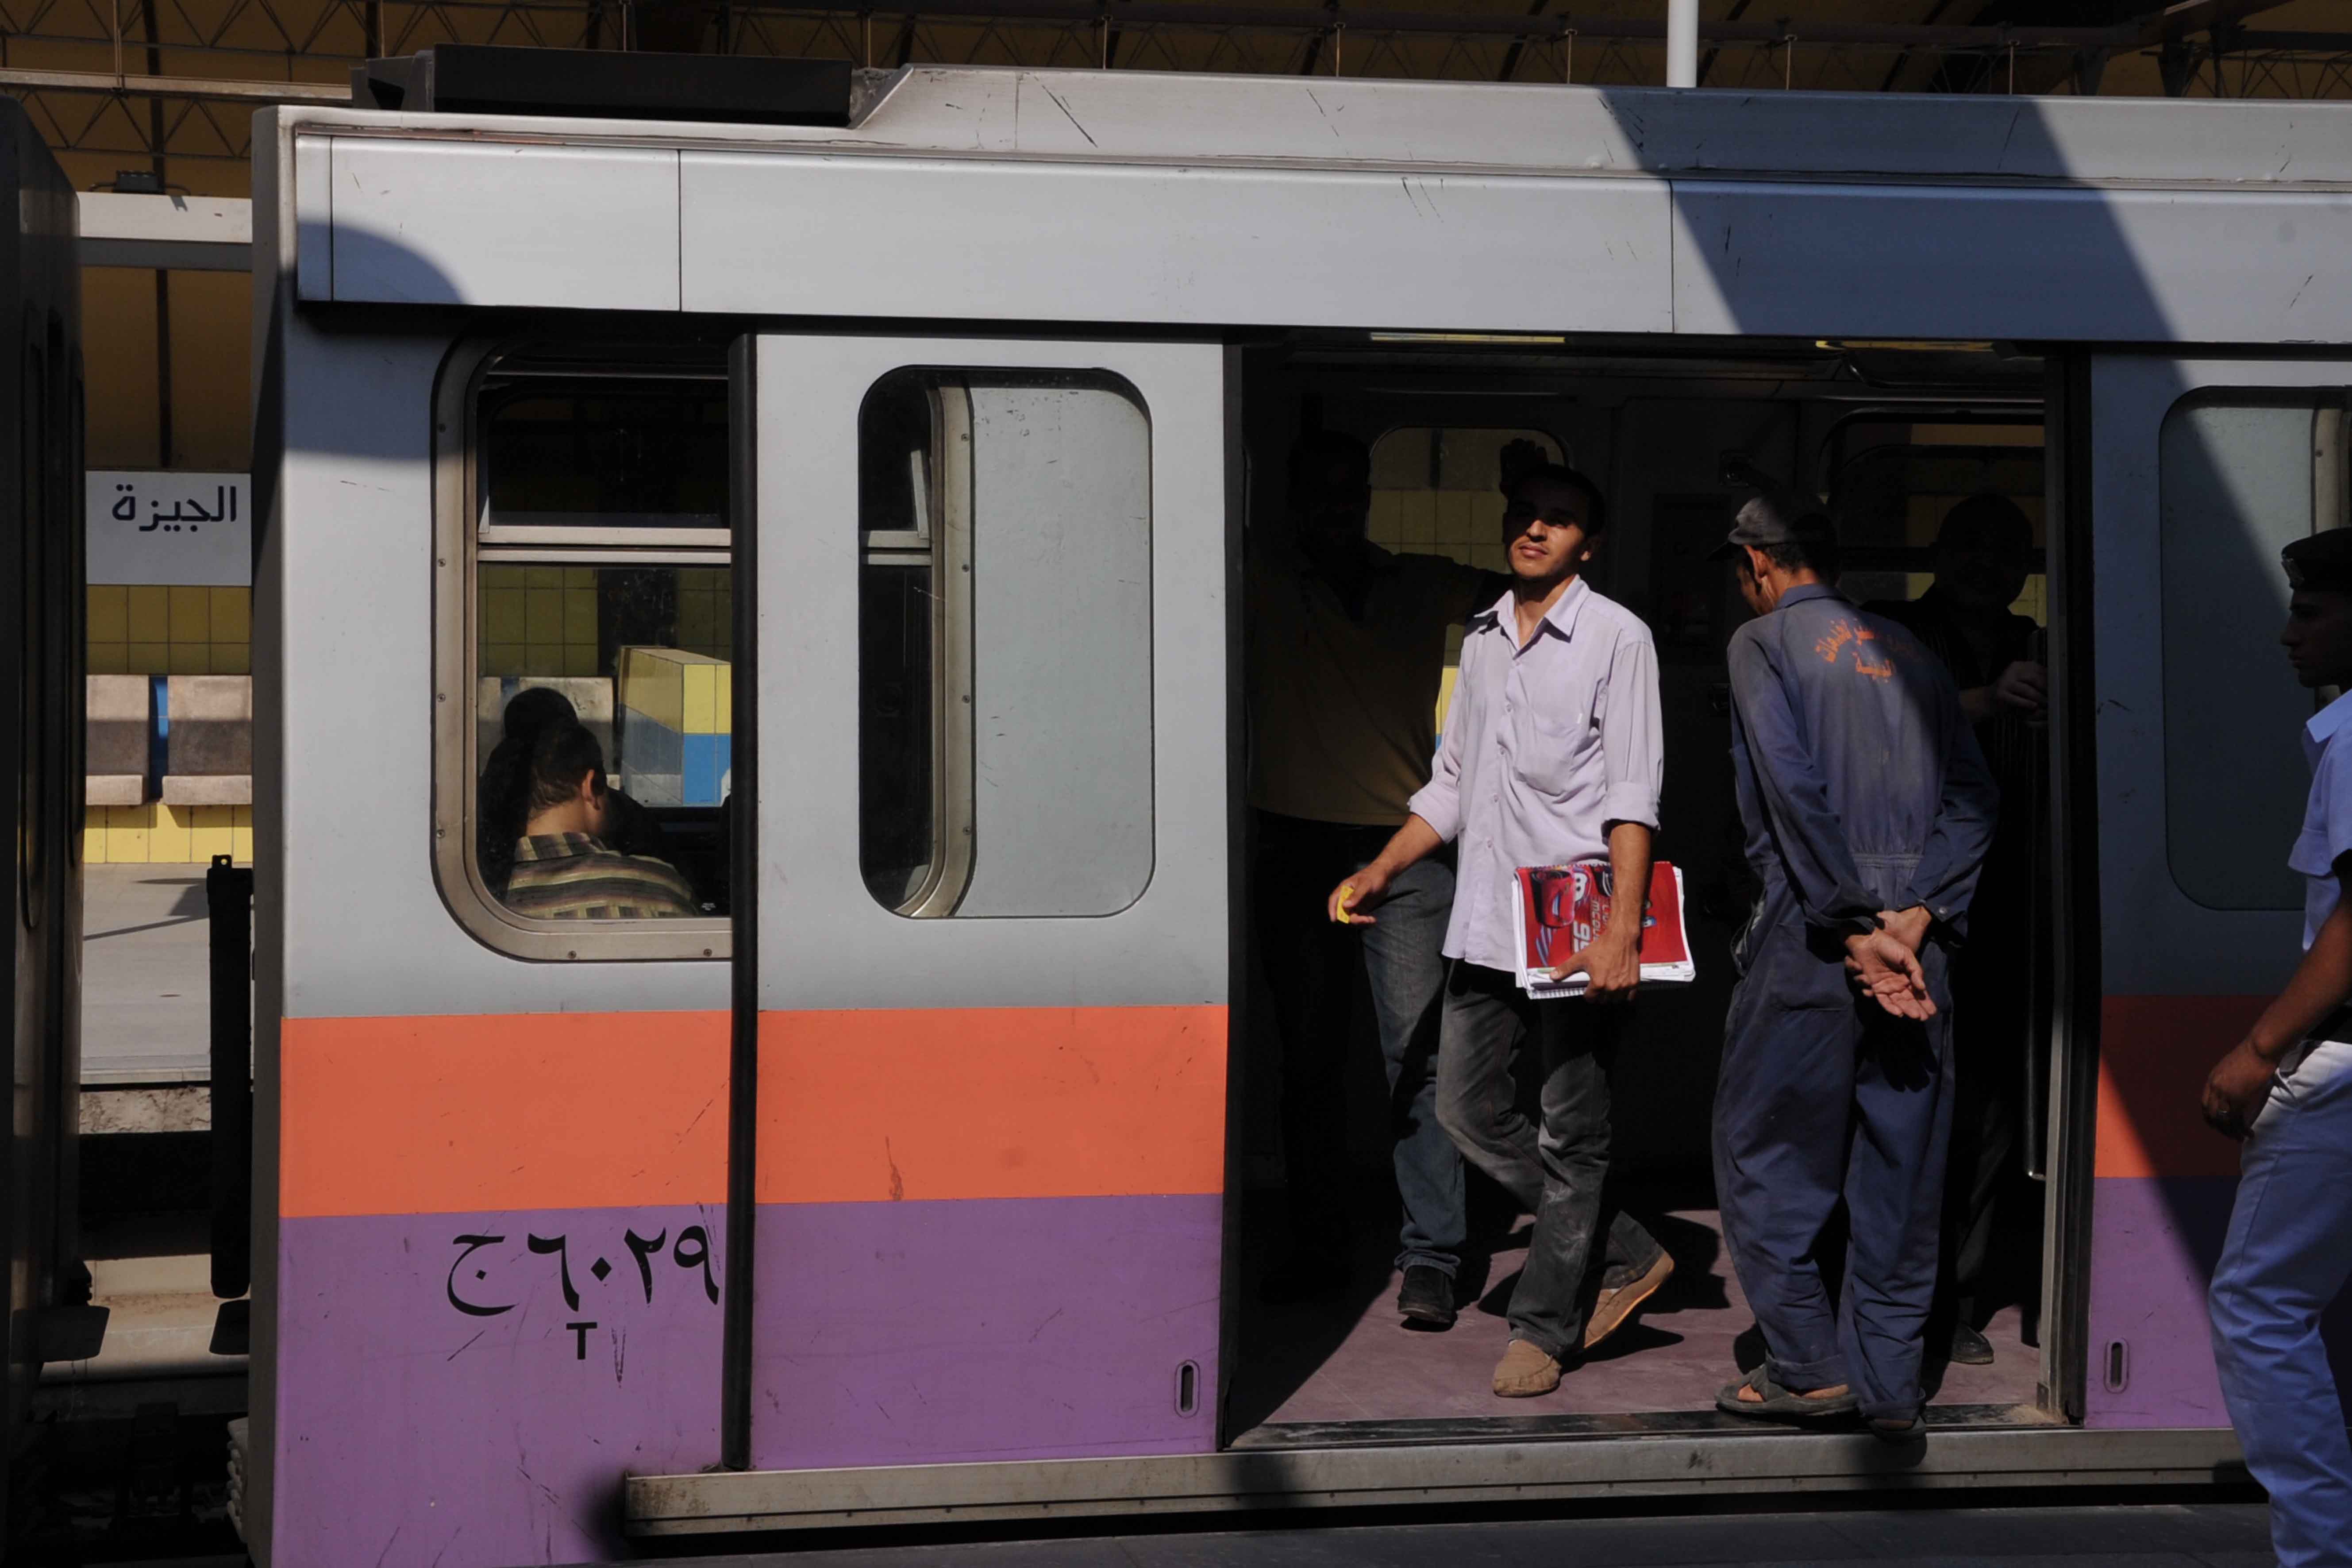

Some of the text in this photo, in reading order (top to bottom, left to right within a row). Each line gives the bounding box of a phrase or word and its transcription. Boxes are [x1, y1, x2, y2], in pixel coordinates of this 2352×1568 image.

[112, 484, 237, 532] الجيزة
[1591, 899, 1601, 941] MCQU
[566, 1321, 598, 1360] T
